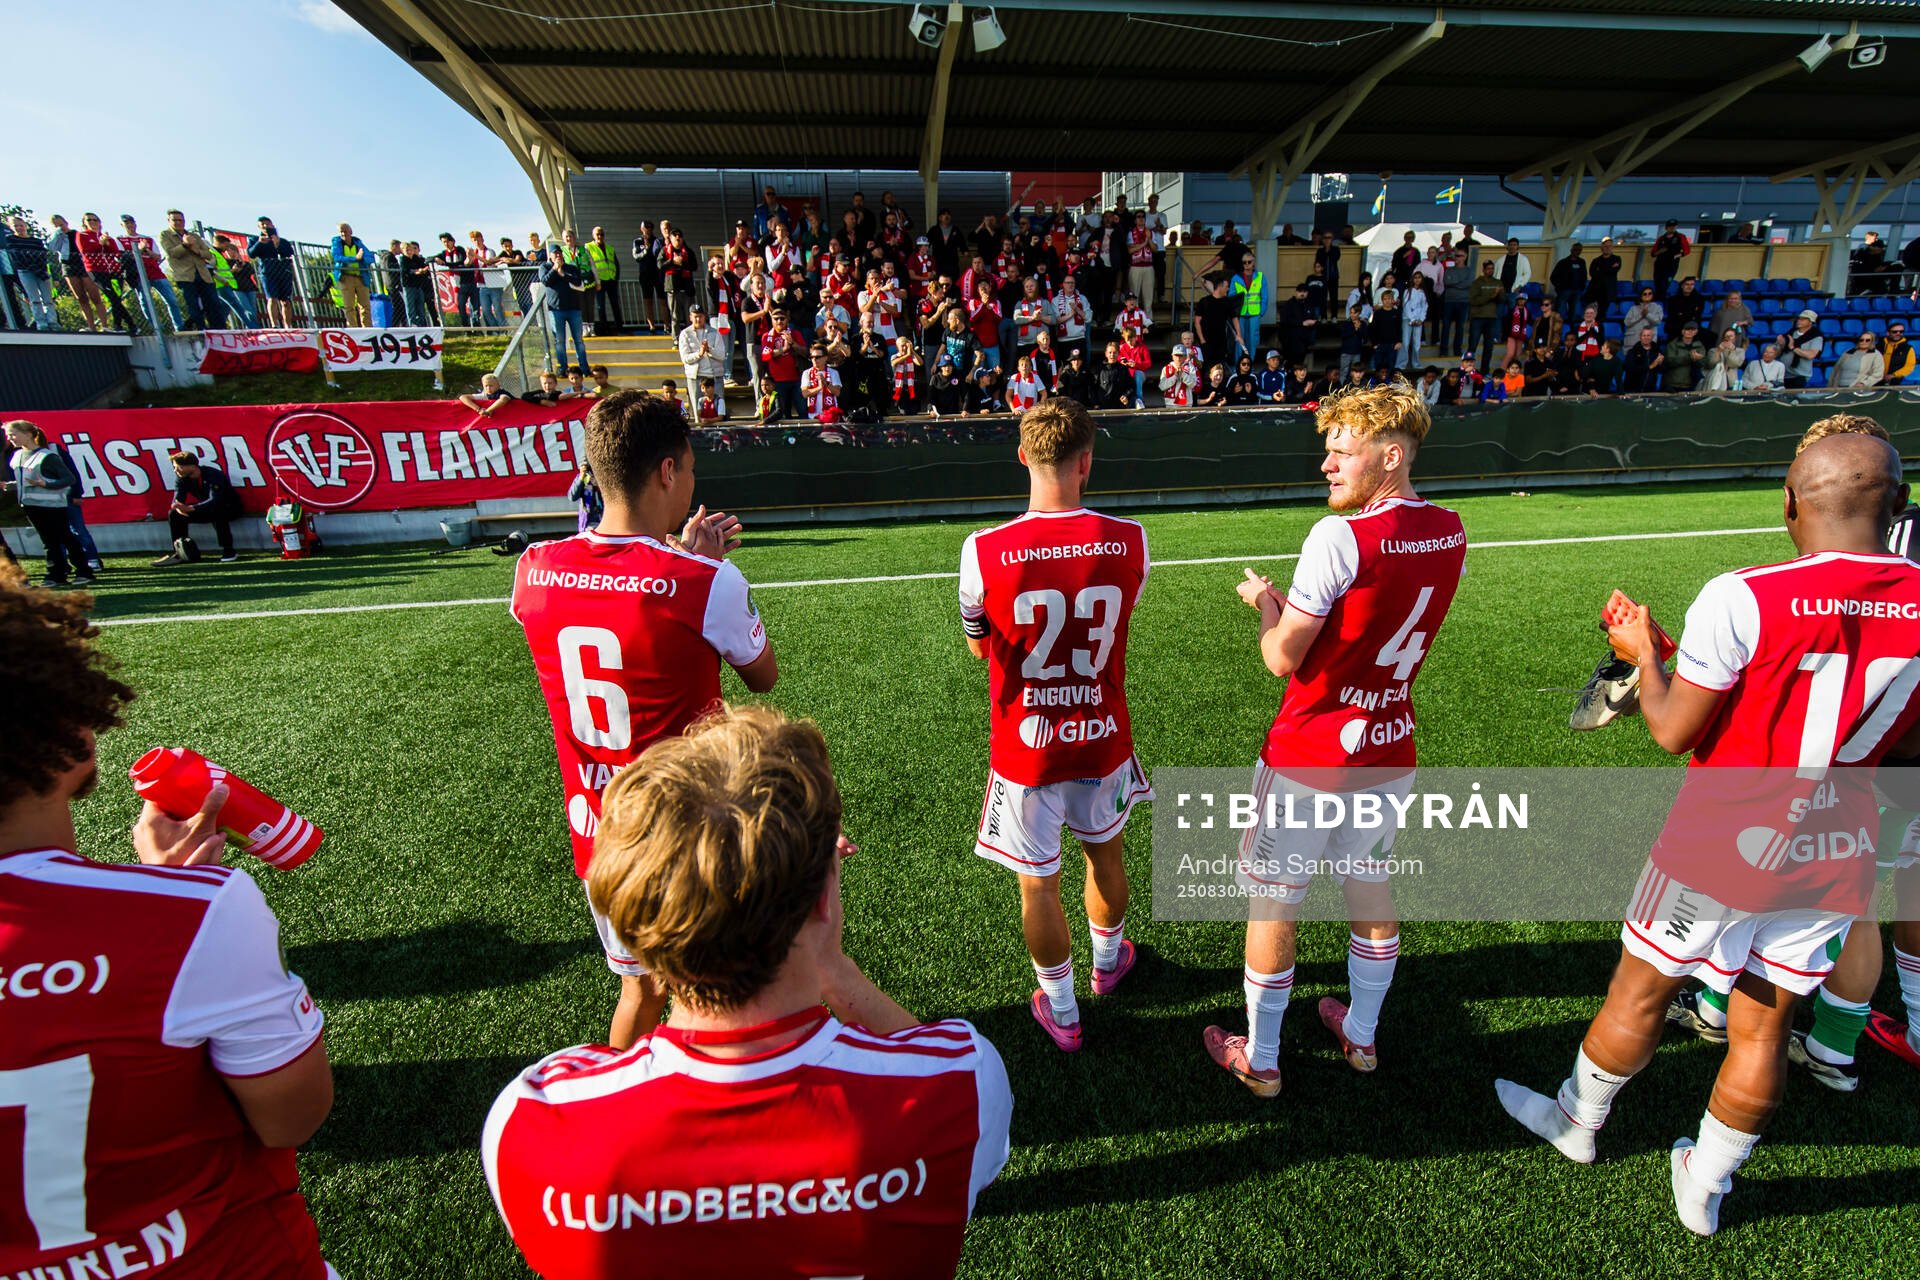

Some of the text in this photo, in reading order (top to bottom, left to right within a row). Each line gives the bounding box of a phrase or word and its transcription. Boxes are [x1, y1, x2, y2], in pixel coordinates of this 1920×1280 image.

[362, 333, 437, 364] 1918
[48, 433, 267, 498] ÄSTRA
[1001, 541, 1127, 566] (LUNDBERG&CO)
[527, 568, 677, 597] (LUNDBERG&CO)
[1791, 598, 1920, 620] (LUNDBERG
[1014, 585, 1122, 681] 23
[1376, 586, 1434, 681] 4
[557, 626, 631, 750] 6
[1340, 686, 1379, 712] VAN
[1058, 714, 1119, 743] GIDA
[1370, 711, 1415, 746] GIDA
[1789, 827, 1876, 863] GIDA
[542, 1158, 928, 1233] (LUNDBERG&CO)
